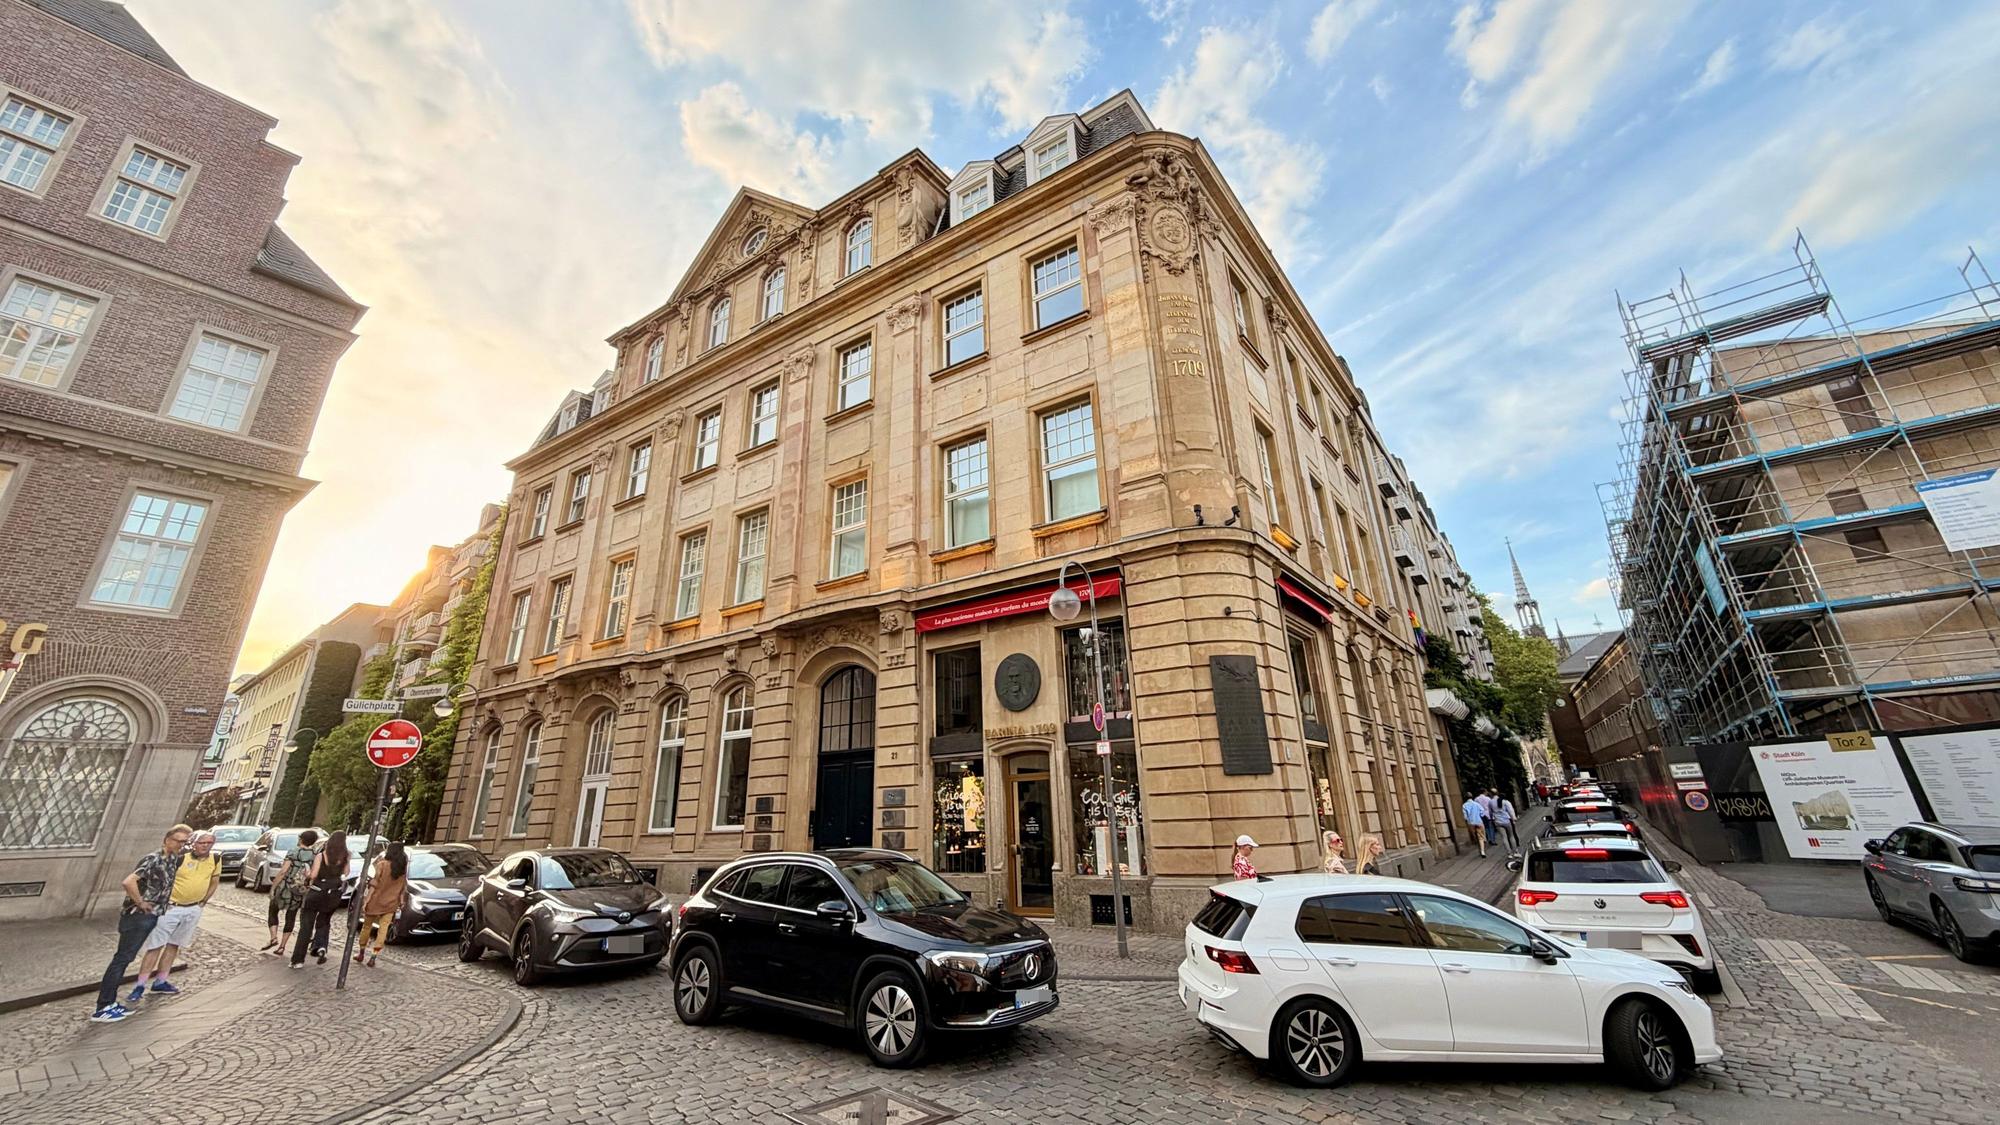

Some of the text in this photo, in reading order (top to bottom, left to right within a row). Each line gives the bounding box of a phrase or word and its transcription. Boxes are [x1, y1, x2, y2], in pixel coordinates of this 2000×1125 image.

[1172, 360, 1205, 377] 1709
[1000, 602, 1021, 614] parfum
[346, 700, 395, 711] Gülichplatz
[1835, 736, 1867, 748] Tor 2
[1091, 805, 1101, 816] IS
